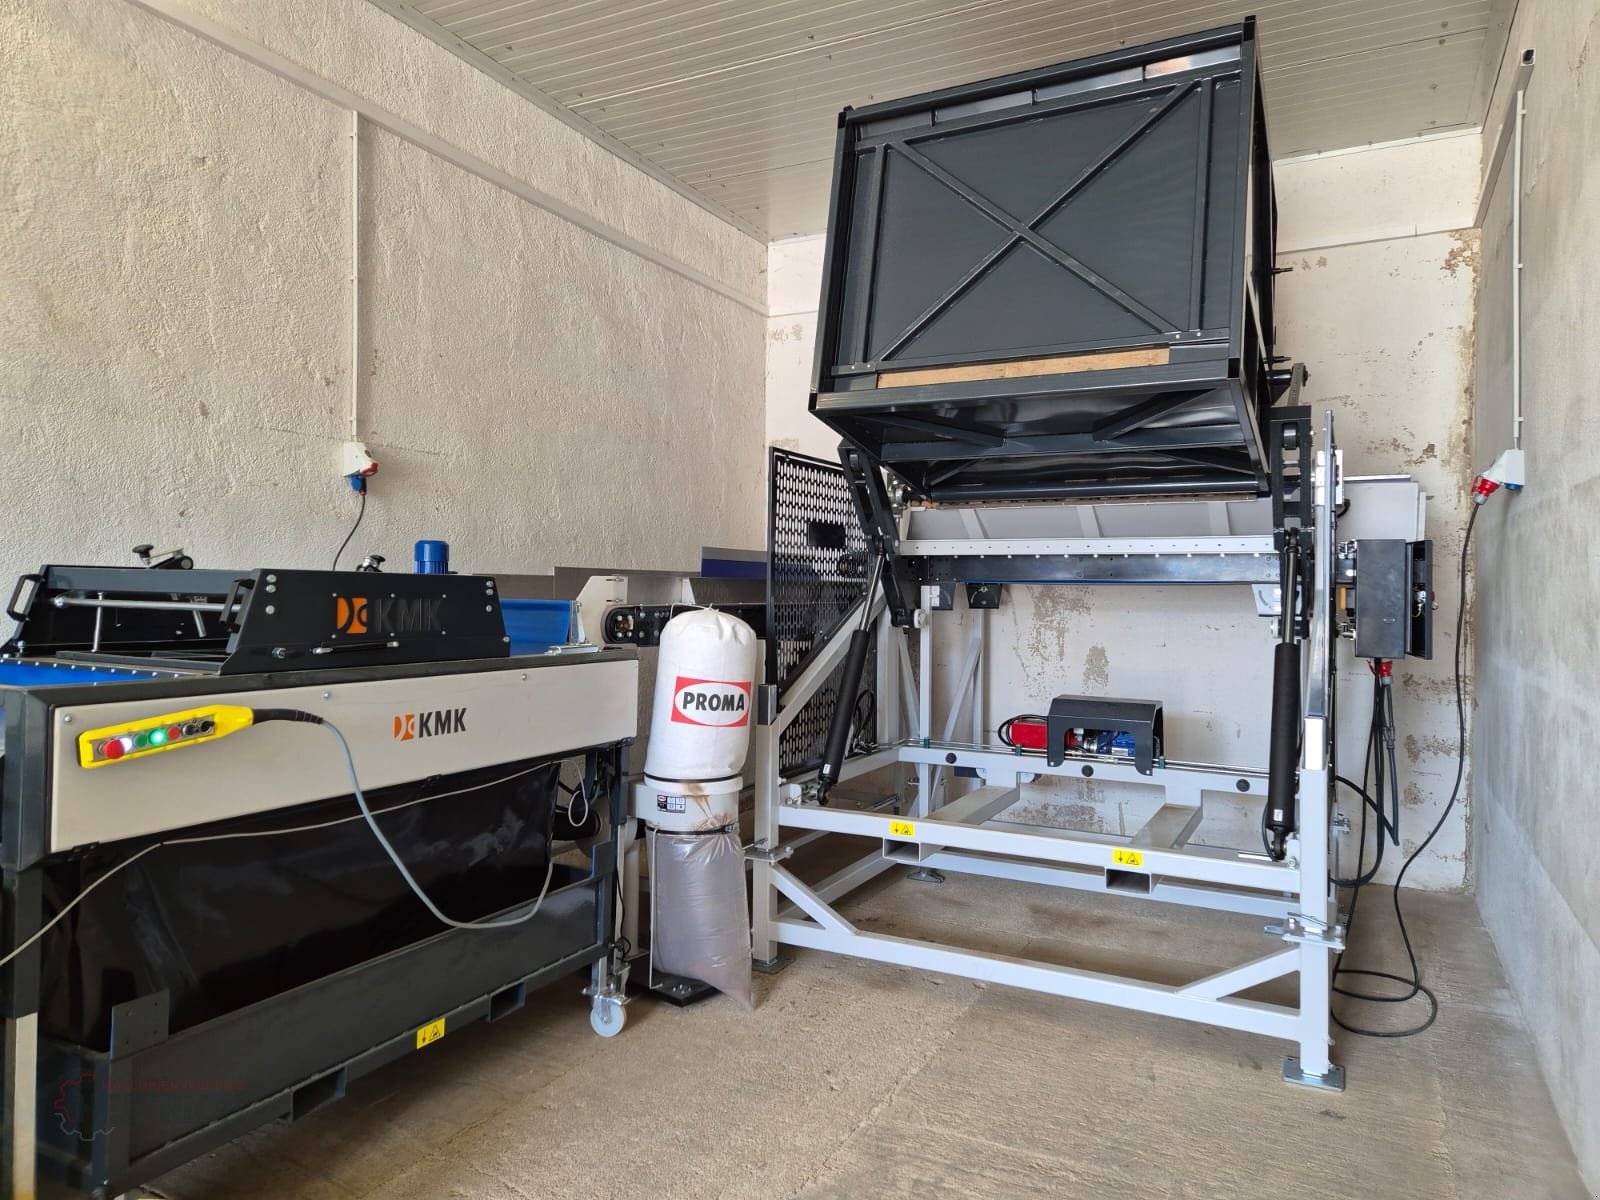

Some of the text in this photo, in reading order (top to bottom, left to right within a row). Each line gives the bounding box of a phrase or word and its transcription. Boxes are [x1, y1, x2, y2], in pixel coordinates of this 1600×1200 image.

[374, 599, 441, 632] KMK
[683, 692, 744, 711] PROMA
[419, 707, 467, 738] KMK
